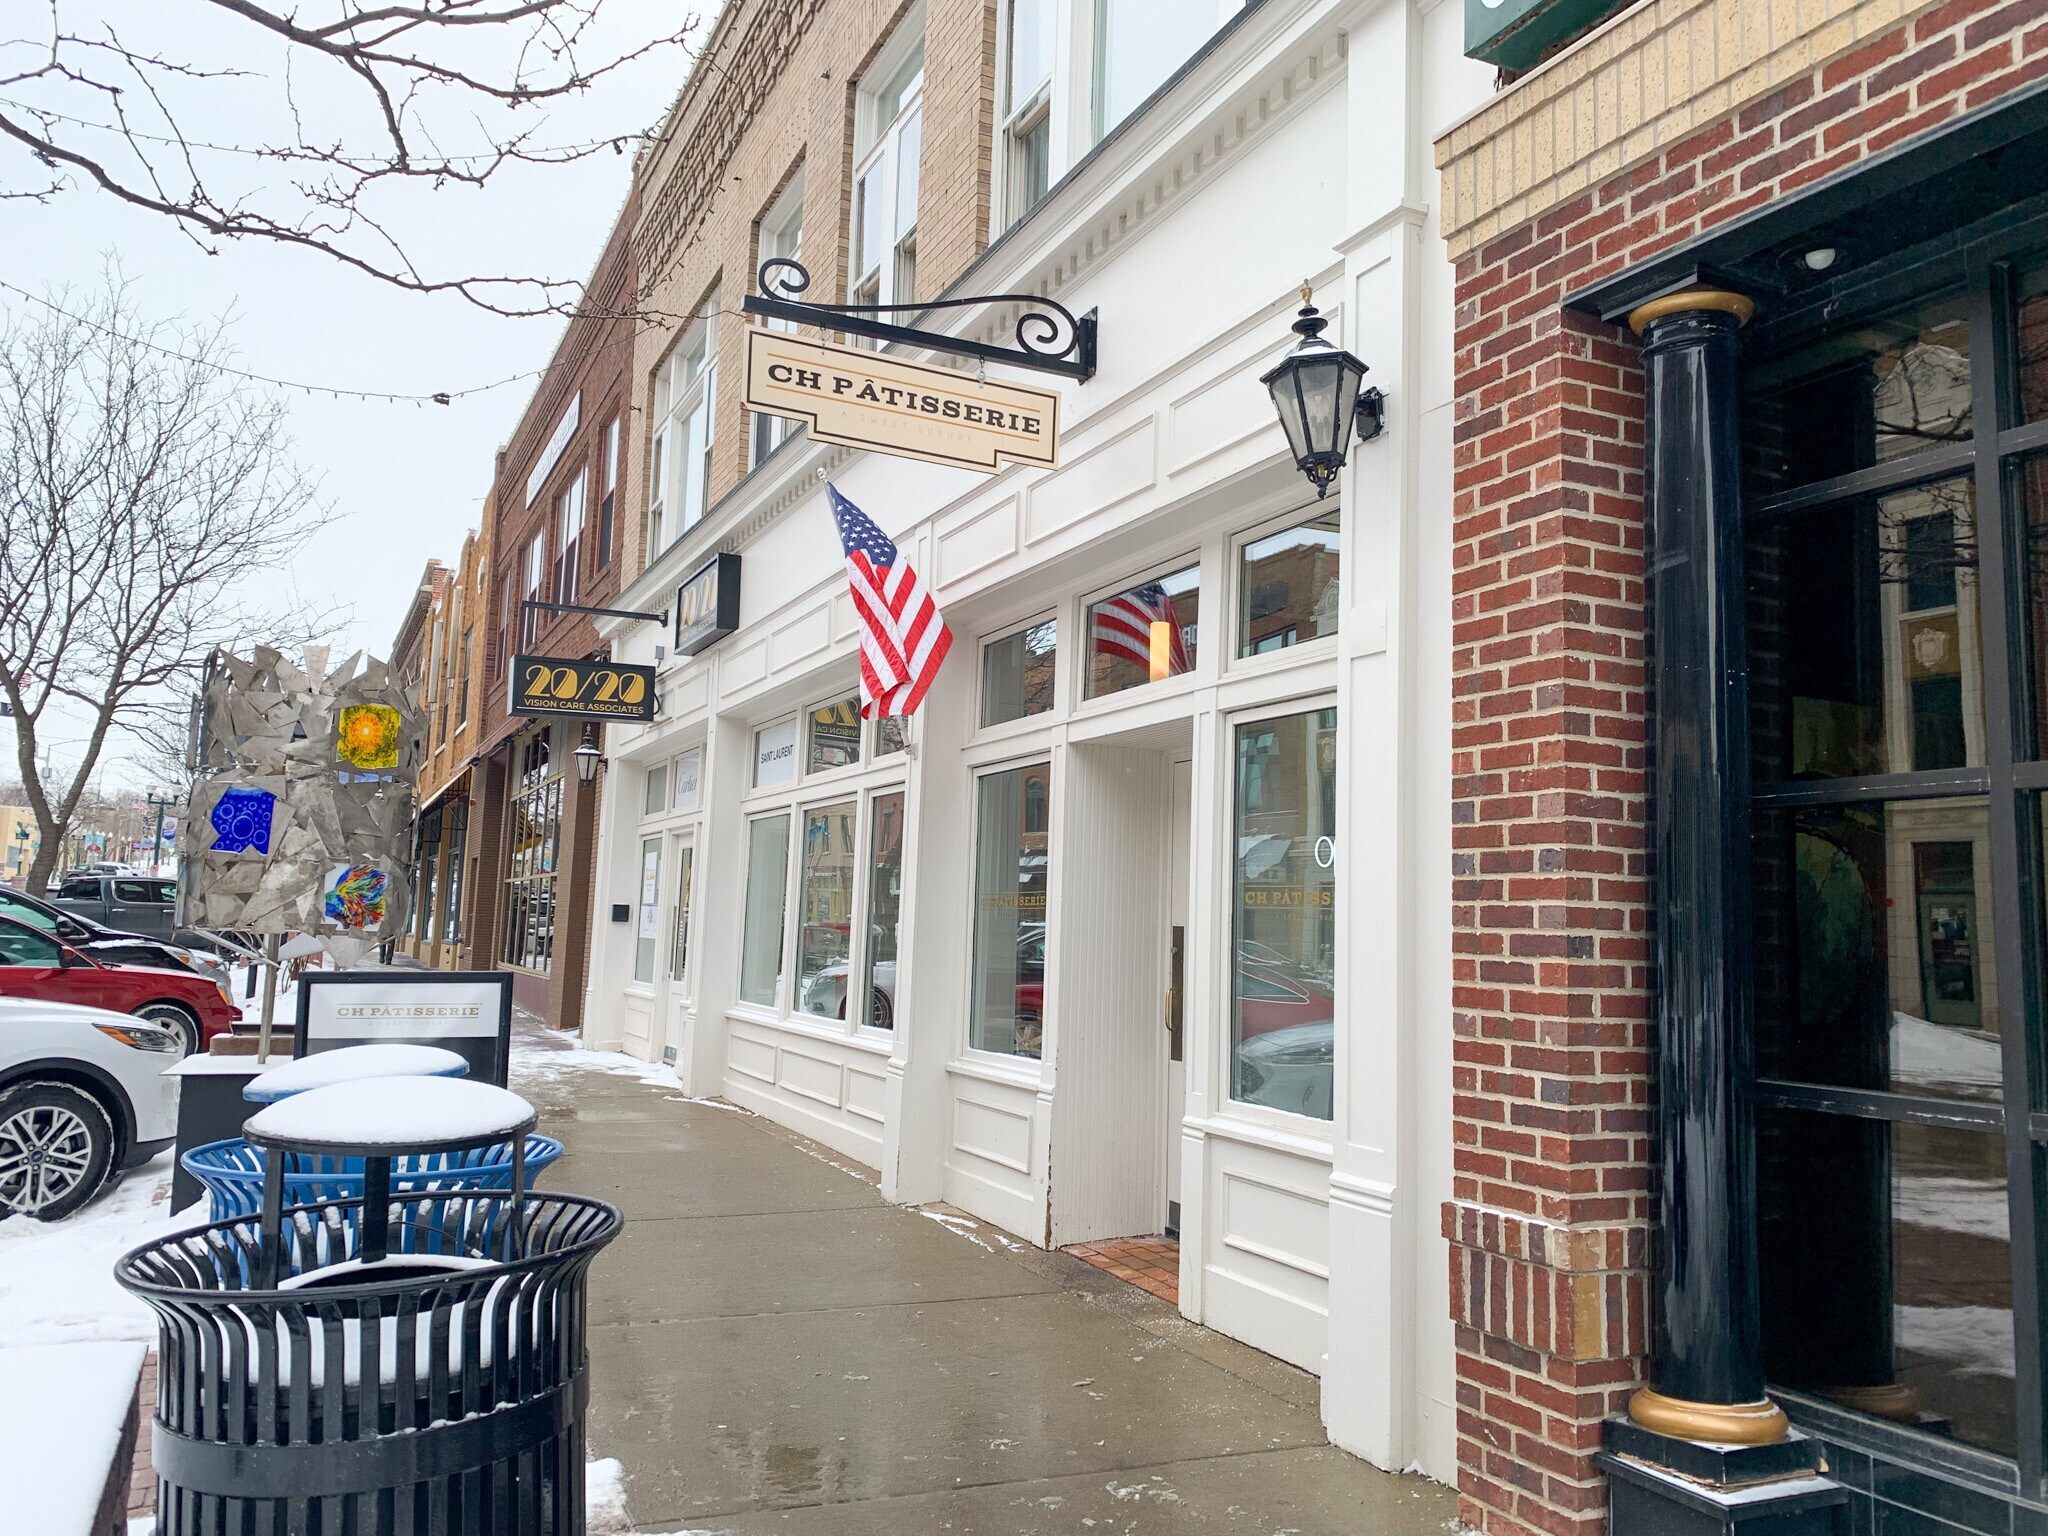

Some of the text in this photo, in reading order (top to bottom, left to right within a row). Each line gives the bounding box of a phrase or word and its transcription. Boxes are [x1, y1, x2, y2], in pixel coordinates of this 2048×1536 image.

[767, 363, 1041, 436] CH PÂTISSERIE
[840, 410, 973, 444] A SWEET LUXURY
[524, 664, 646, 704] 20/20
[524, 698, 645, 715] VISION CARE ASSOCIATES
[761, 744, 794, 764] SAINT LAURENT
[678, 771, 698, 795] Cartier
[1244, 888, 1333, 905] CH PÂTISS
[337, 1005, 479, 1016] CH PÂTISSERIE
